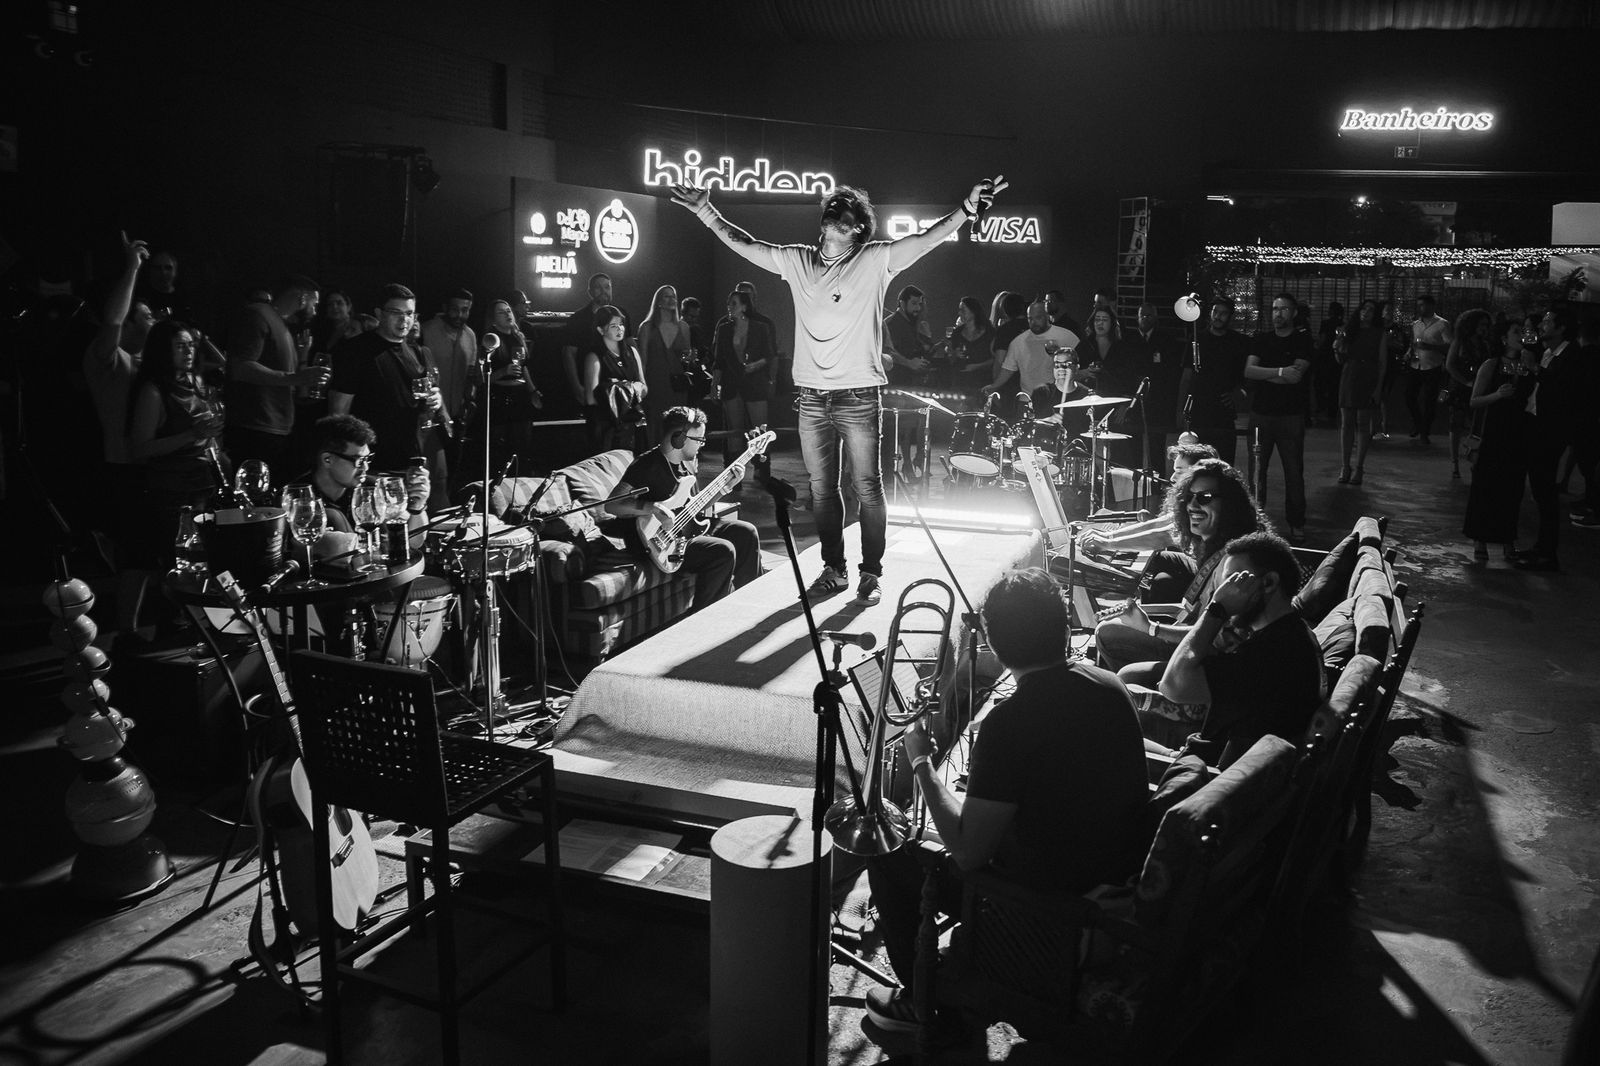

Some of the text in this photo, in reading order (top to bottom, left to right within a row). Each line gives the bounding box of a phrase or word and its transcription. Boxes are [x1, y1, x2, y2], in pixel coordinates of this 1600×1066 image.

[1340, 107, 1494, 131] Banheiros
[644, 148, 836, 194] hidden
[969, 215, 1041, 243] VISA
